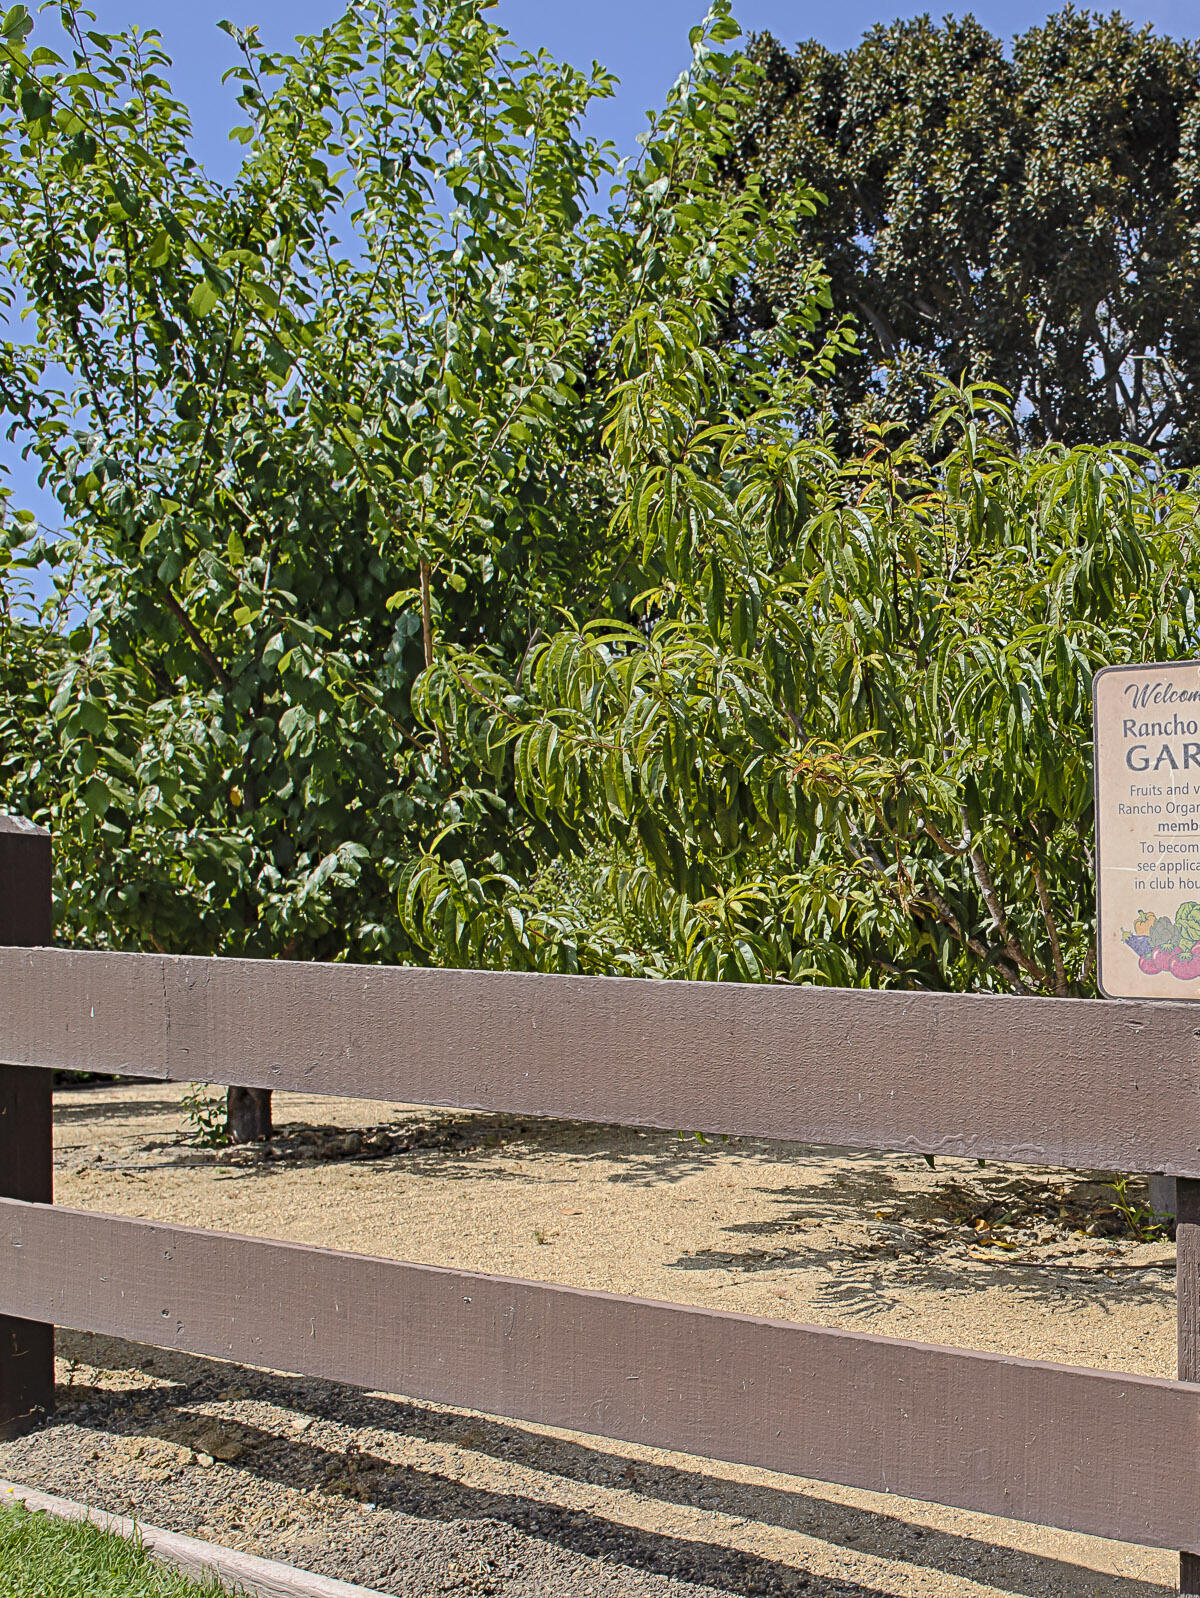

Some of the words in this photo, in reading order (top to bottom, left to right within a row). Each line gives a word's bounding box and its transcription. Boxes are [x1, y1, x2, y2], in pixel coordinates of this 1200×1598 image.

[1123, 713, 1198, 737] Rancho
[1130, 785, 1162, 796] Fruits
[1166, 782, 1189, 796] and
[1118, 801, 1162, 815] Rancho
[1140, 841, 1154, 853] To
[1137, 862, 1156, 872] see
[1135, 877, 1145, 889] in
[1150, 877, 1174, 889] club
